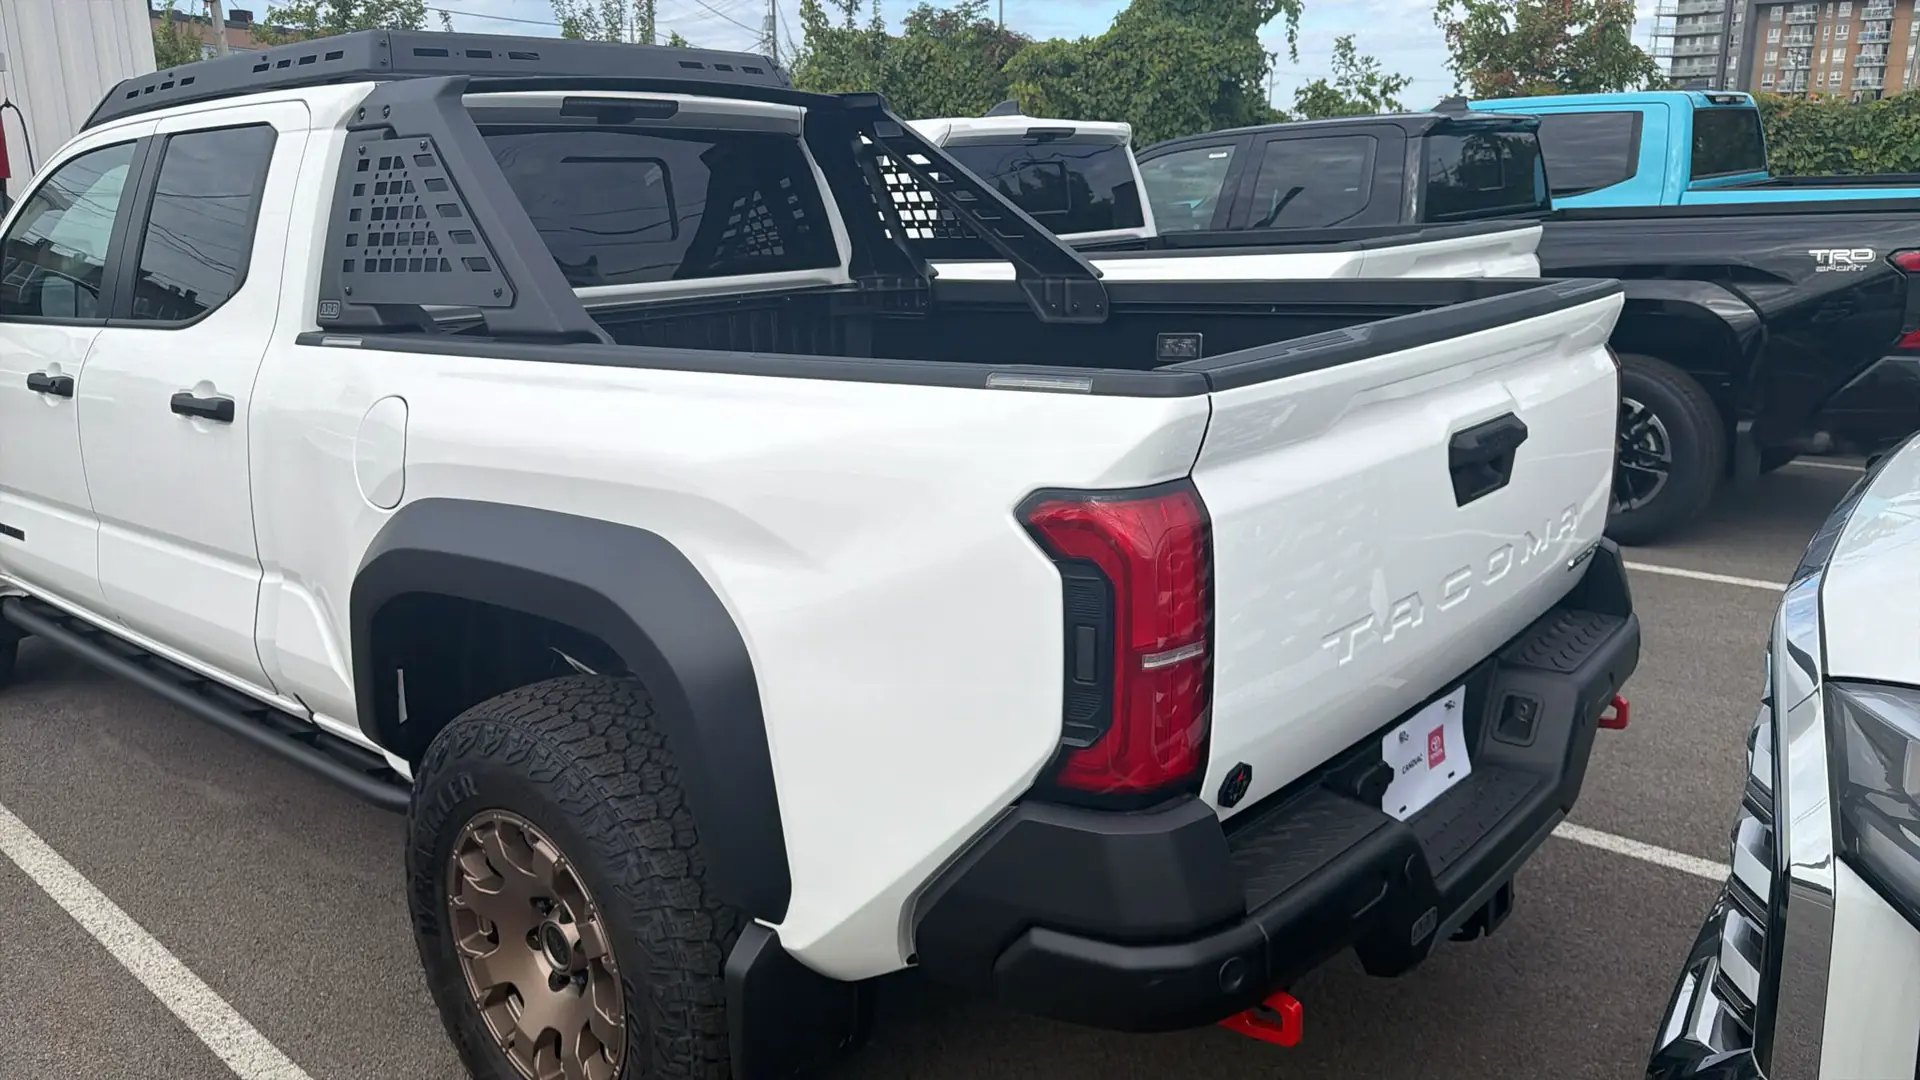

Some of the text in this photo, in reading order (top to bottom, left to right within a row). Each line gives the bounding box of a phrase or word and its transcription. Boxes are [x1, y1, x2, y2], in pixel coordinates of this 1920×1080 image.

[1808, 249, 1876, 265] TRD
[320, 303, 338, 315] ARB
[1321, 503, 1578, 667] TACOMA
